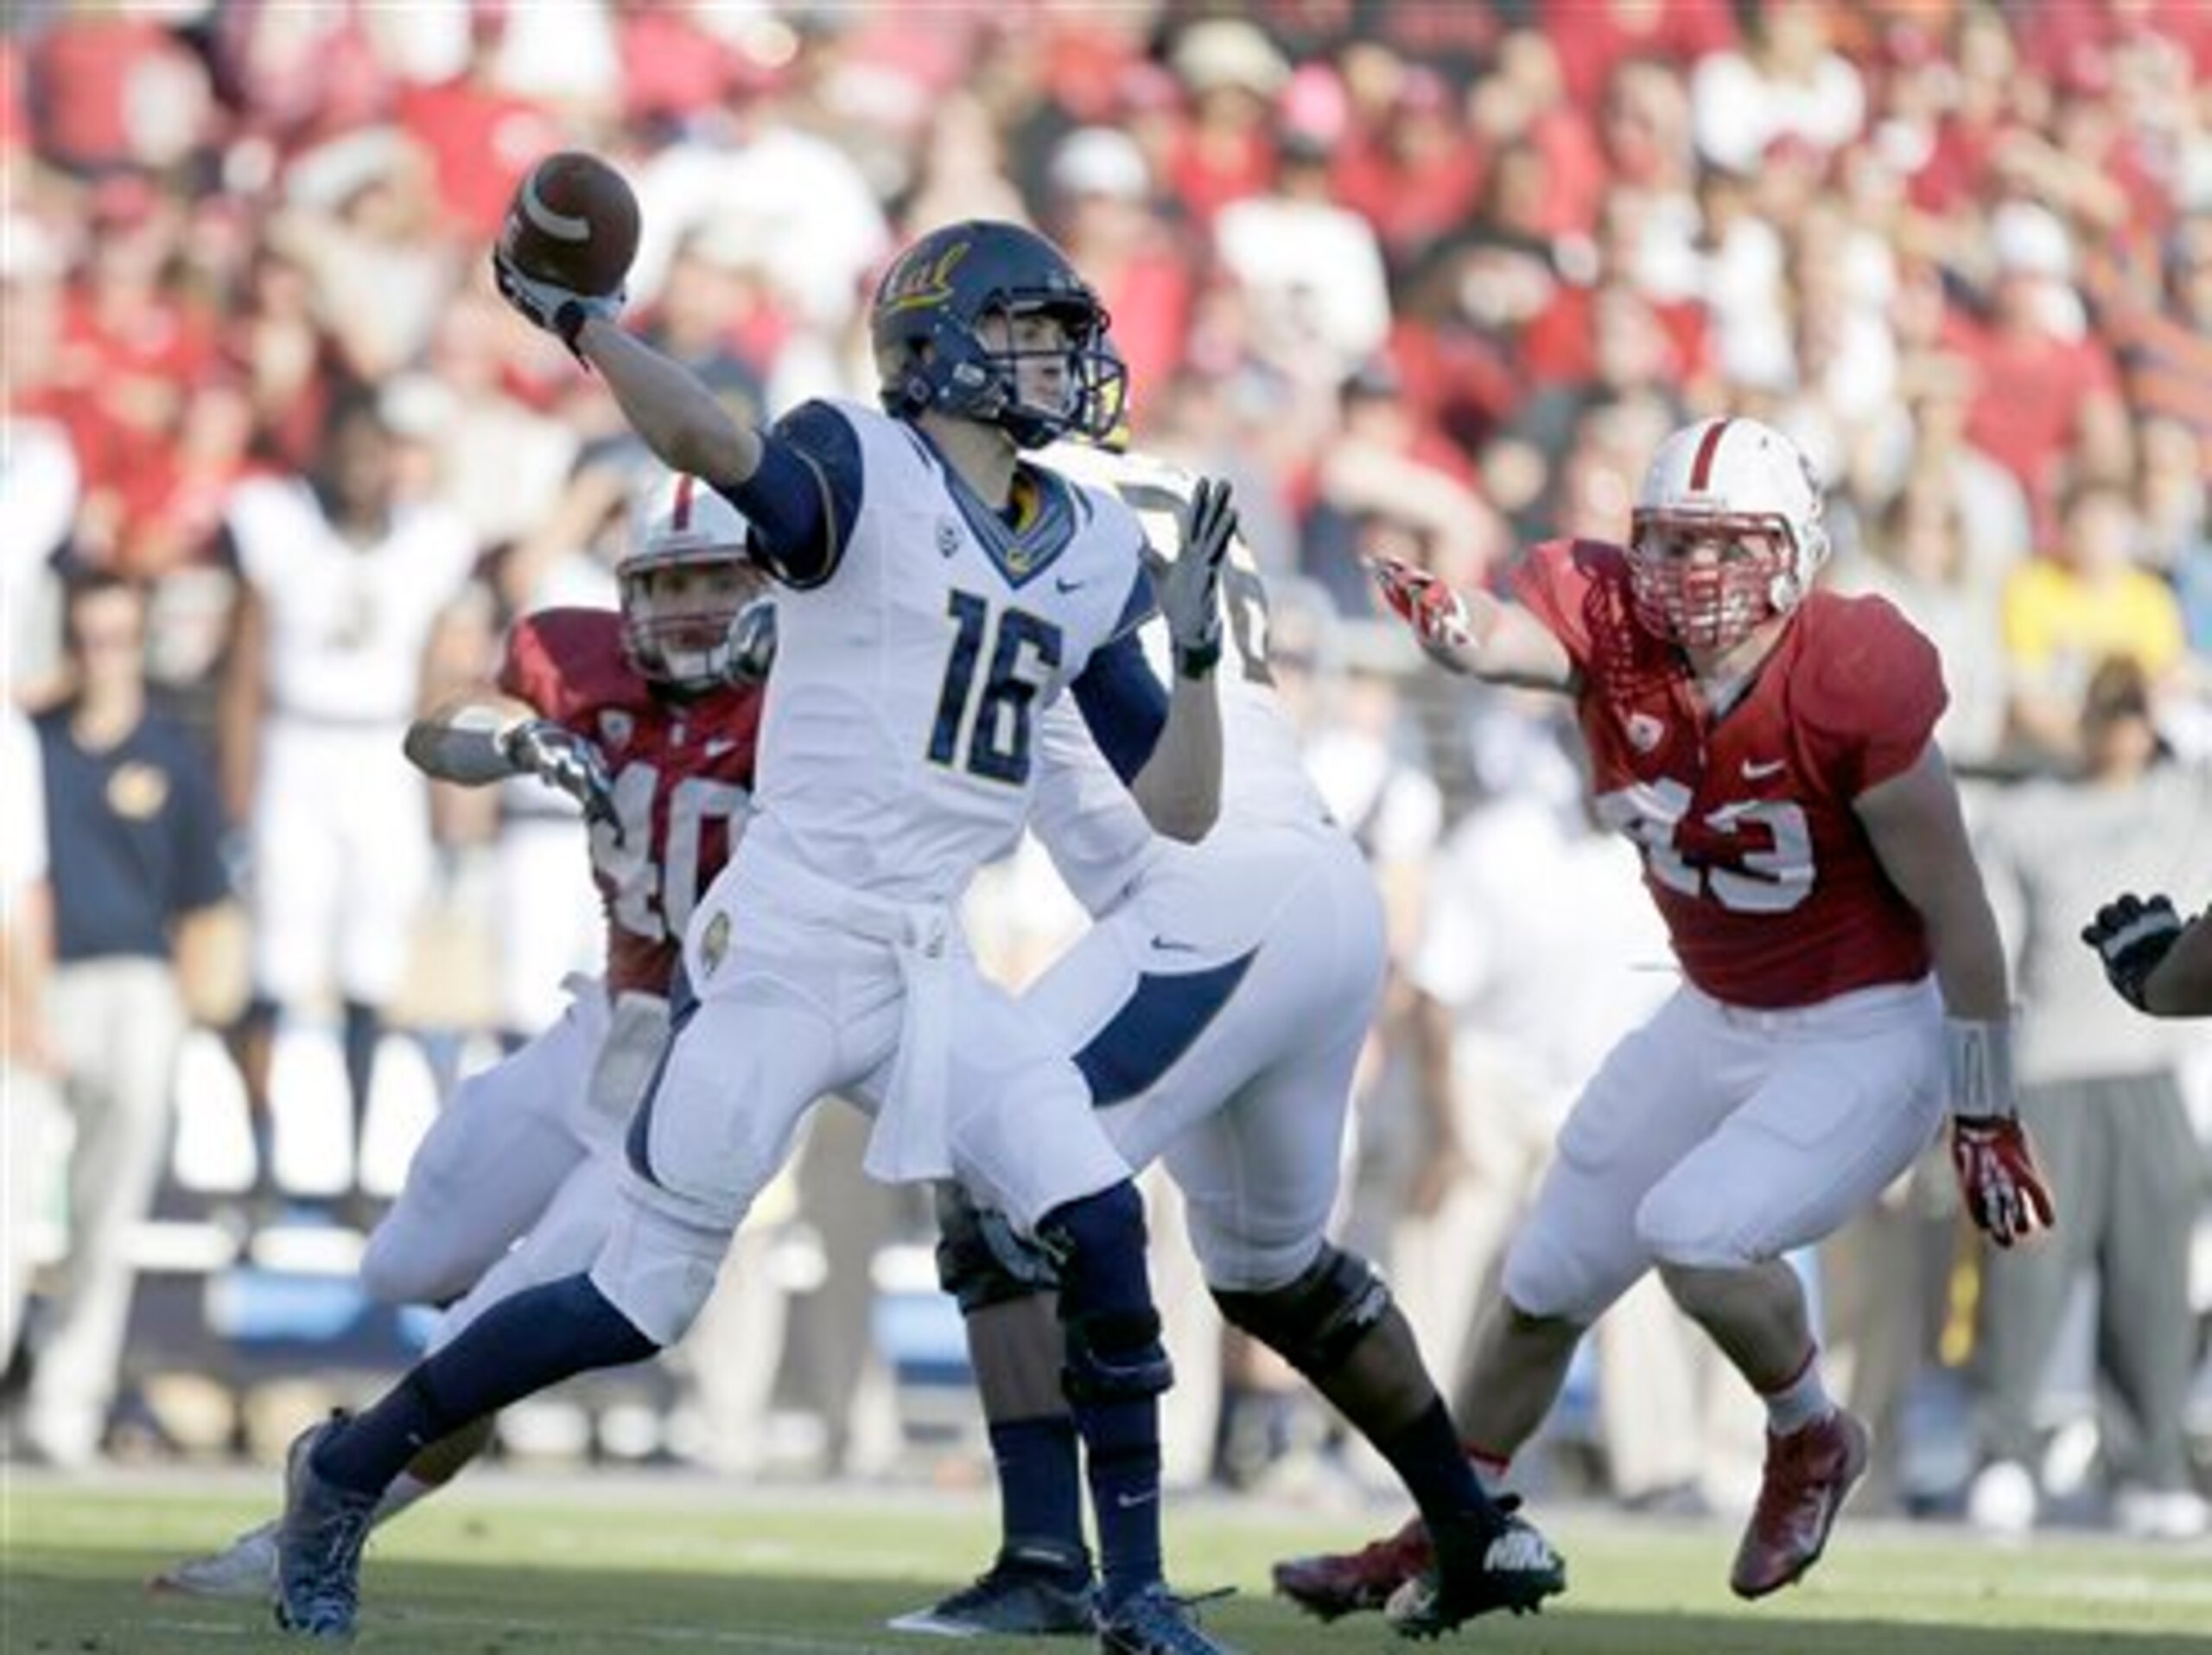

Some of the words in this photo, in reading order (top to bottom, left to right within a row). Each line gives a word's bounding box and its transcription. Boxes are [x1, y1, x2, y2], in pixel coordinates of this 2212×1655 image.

[881, 241, 970, 315] Cal
[926, 589, 1063, 786] 16
[591, 761, 753, 945] 40
